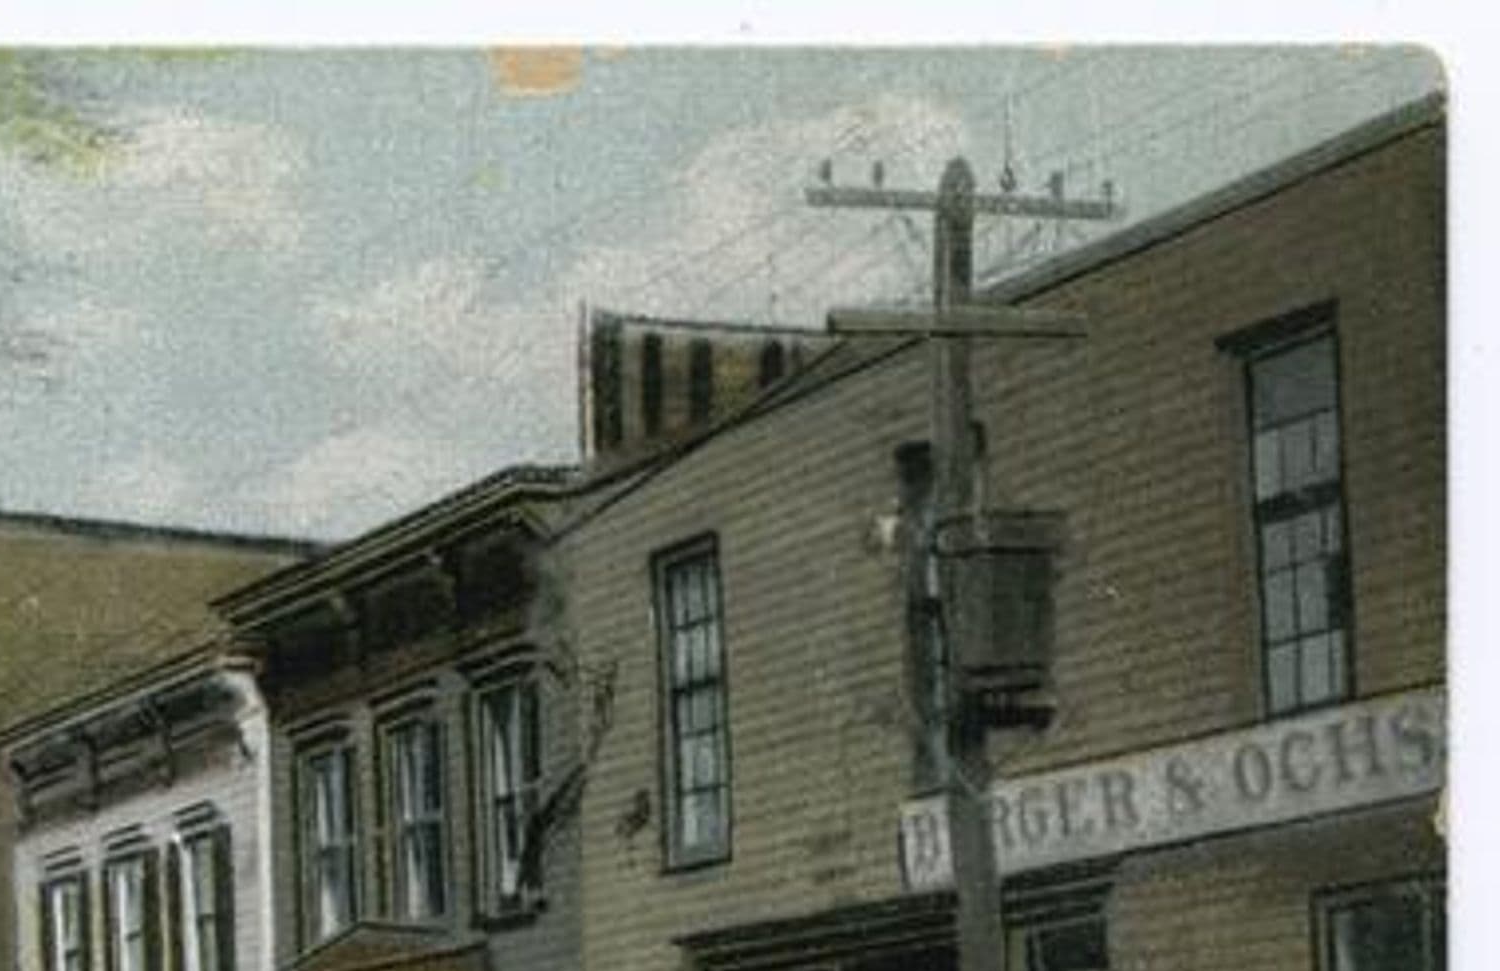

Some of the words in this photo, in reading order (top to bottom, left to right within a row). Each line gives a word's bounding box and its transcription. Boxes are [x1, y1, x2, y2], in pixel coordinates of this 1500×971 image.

[907, 768, 1142, 874] BRGER
[1164, 753, 1204, 816] &
[1232, 703, 1439, 803] OCHS
